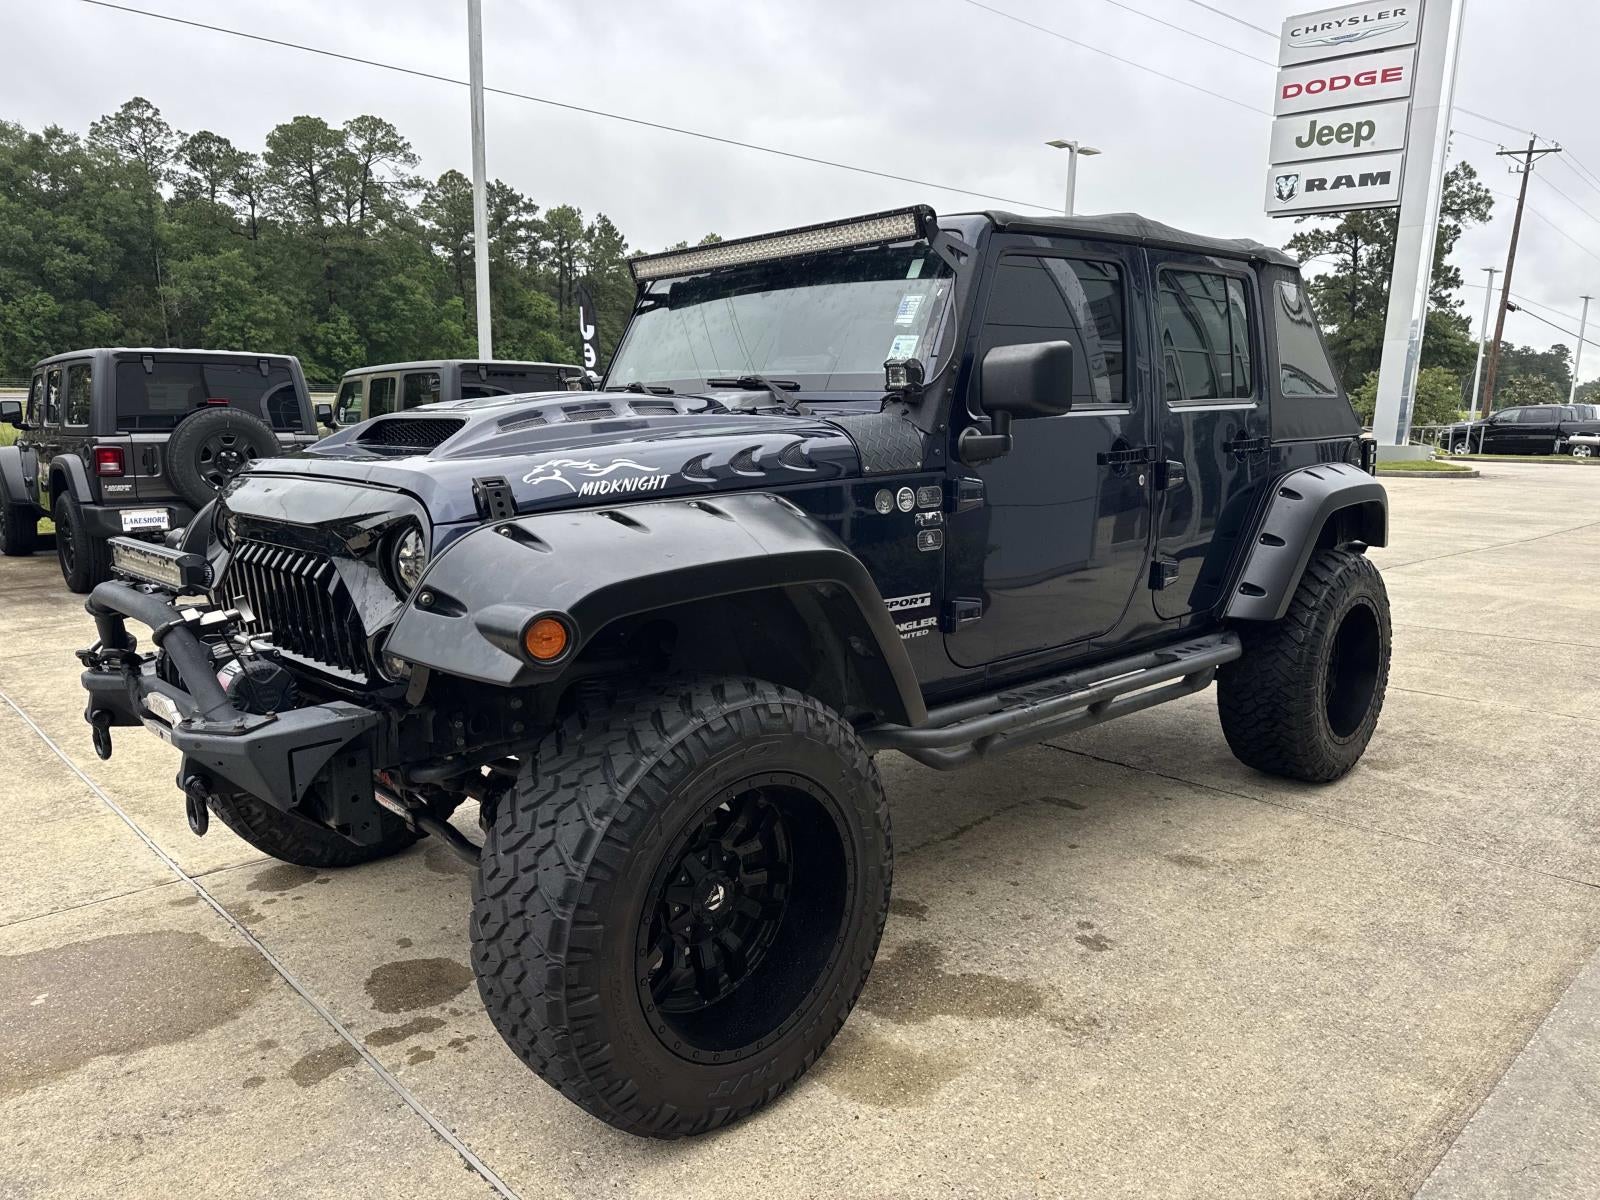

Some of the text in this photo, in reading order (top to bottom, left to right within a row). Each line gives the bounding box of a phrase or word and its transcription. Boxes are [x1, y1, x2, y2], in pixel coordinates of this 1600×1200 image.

[1290, 8, 1407, 38] CHRYSLER
[1282, 66, 1404, 100] DODGE
[1295, 119, 1376, 149] Jeep
[1304, 170, 1392, 193] RAM
[577, 474, 671, 498] MIDKNIGHT
[124, 516, 166, 525] LAKESHORE
